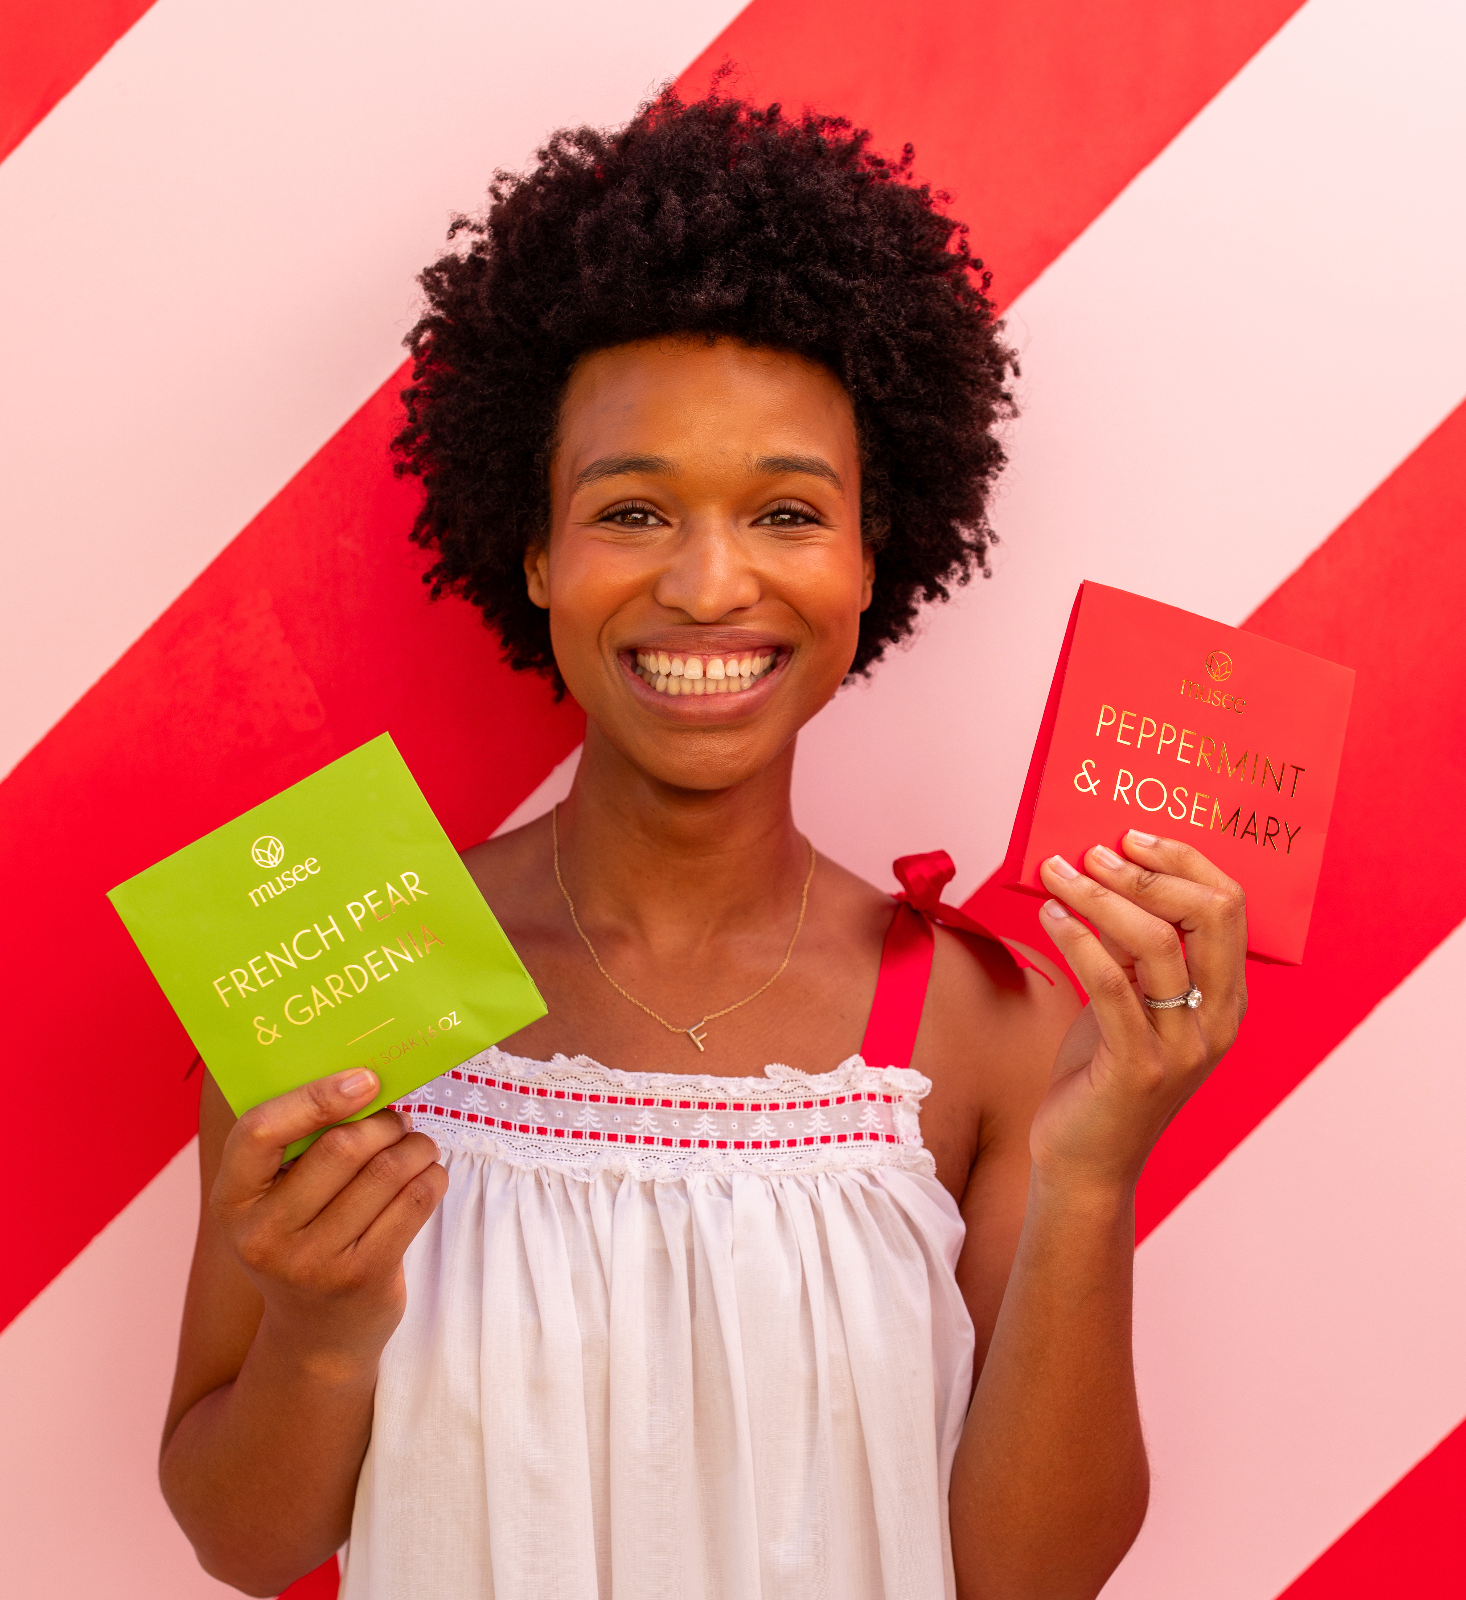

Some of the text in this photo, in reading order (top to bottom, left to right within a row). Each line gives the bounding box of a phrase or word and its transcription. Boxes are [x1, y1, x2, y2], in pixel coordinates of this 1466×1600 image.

[1180, 678, 1246, 714] musee
[1095, 704, 1306, 798] PEPPERMINT
[1073, 759, 1302, 855] & ROSEMARY
[248, 856, 321, 907] musee
[212, 870, 429, 1008] FRENCH PEAR
[252, 924, 445, 1046] & GARDENIA
[379, 1035, 420, 1065] SOAK
[428, 1026, 438, 1039] 6
[438, 1010, 462, 1031] OZ
[687, 1021, 708, 1052] F
